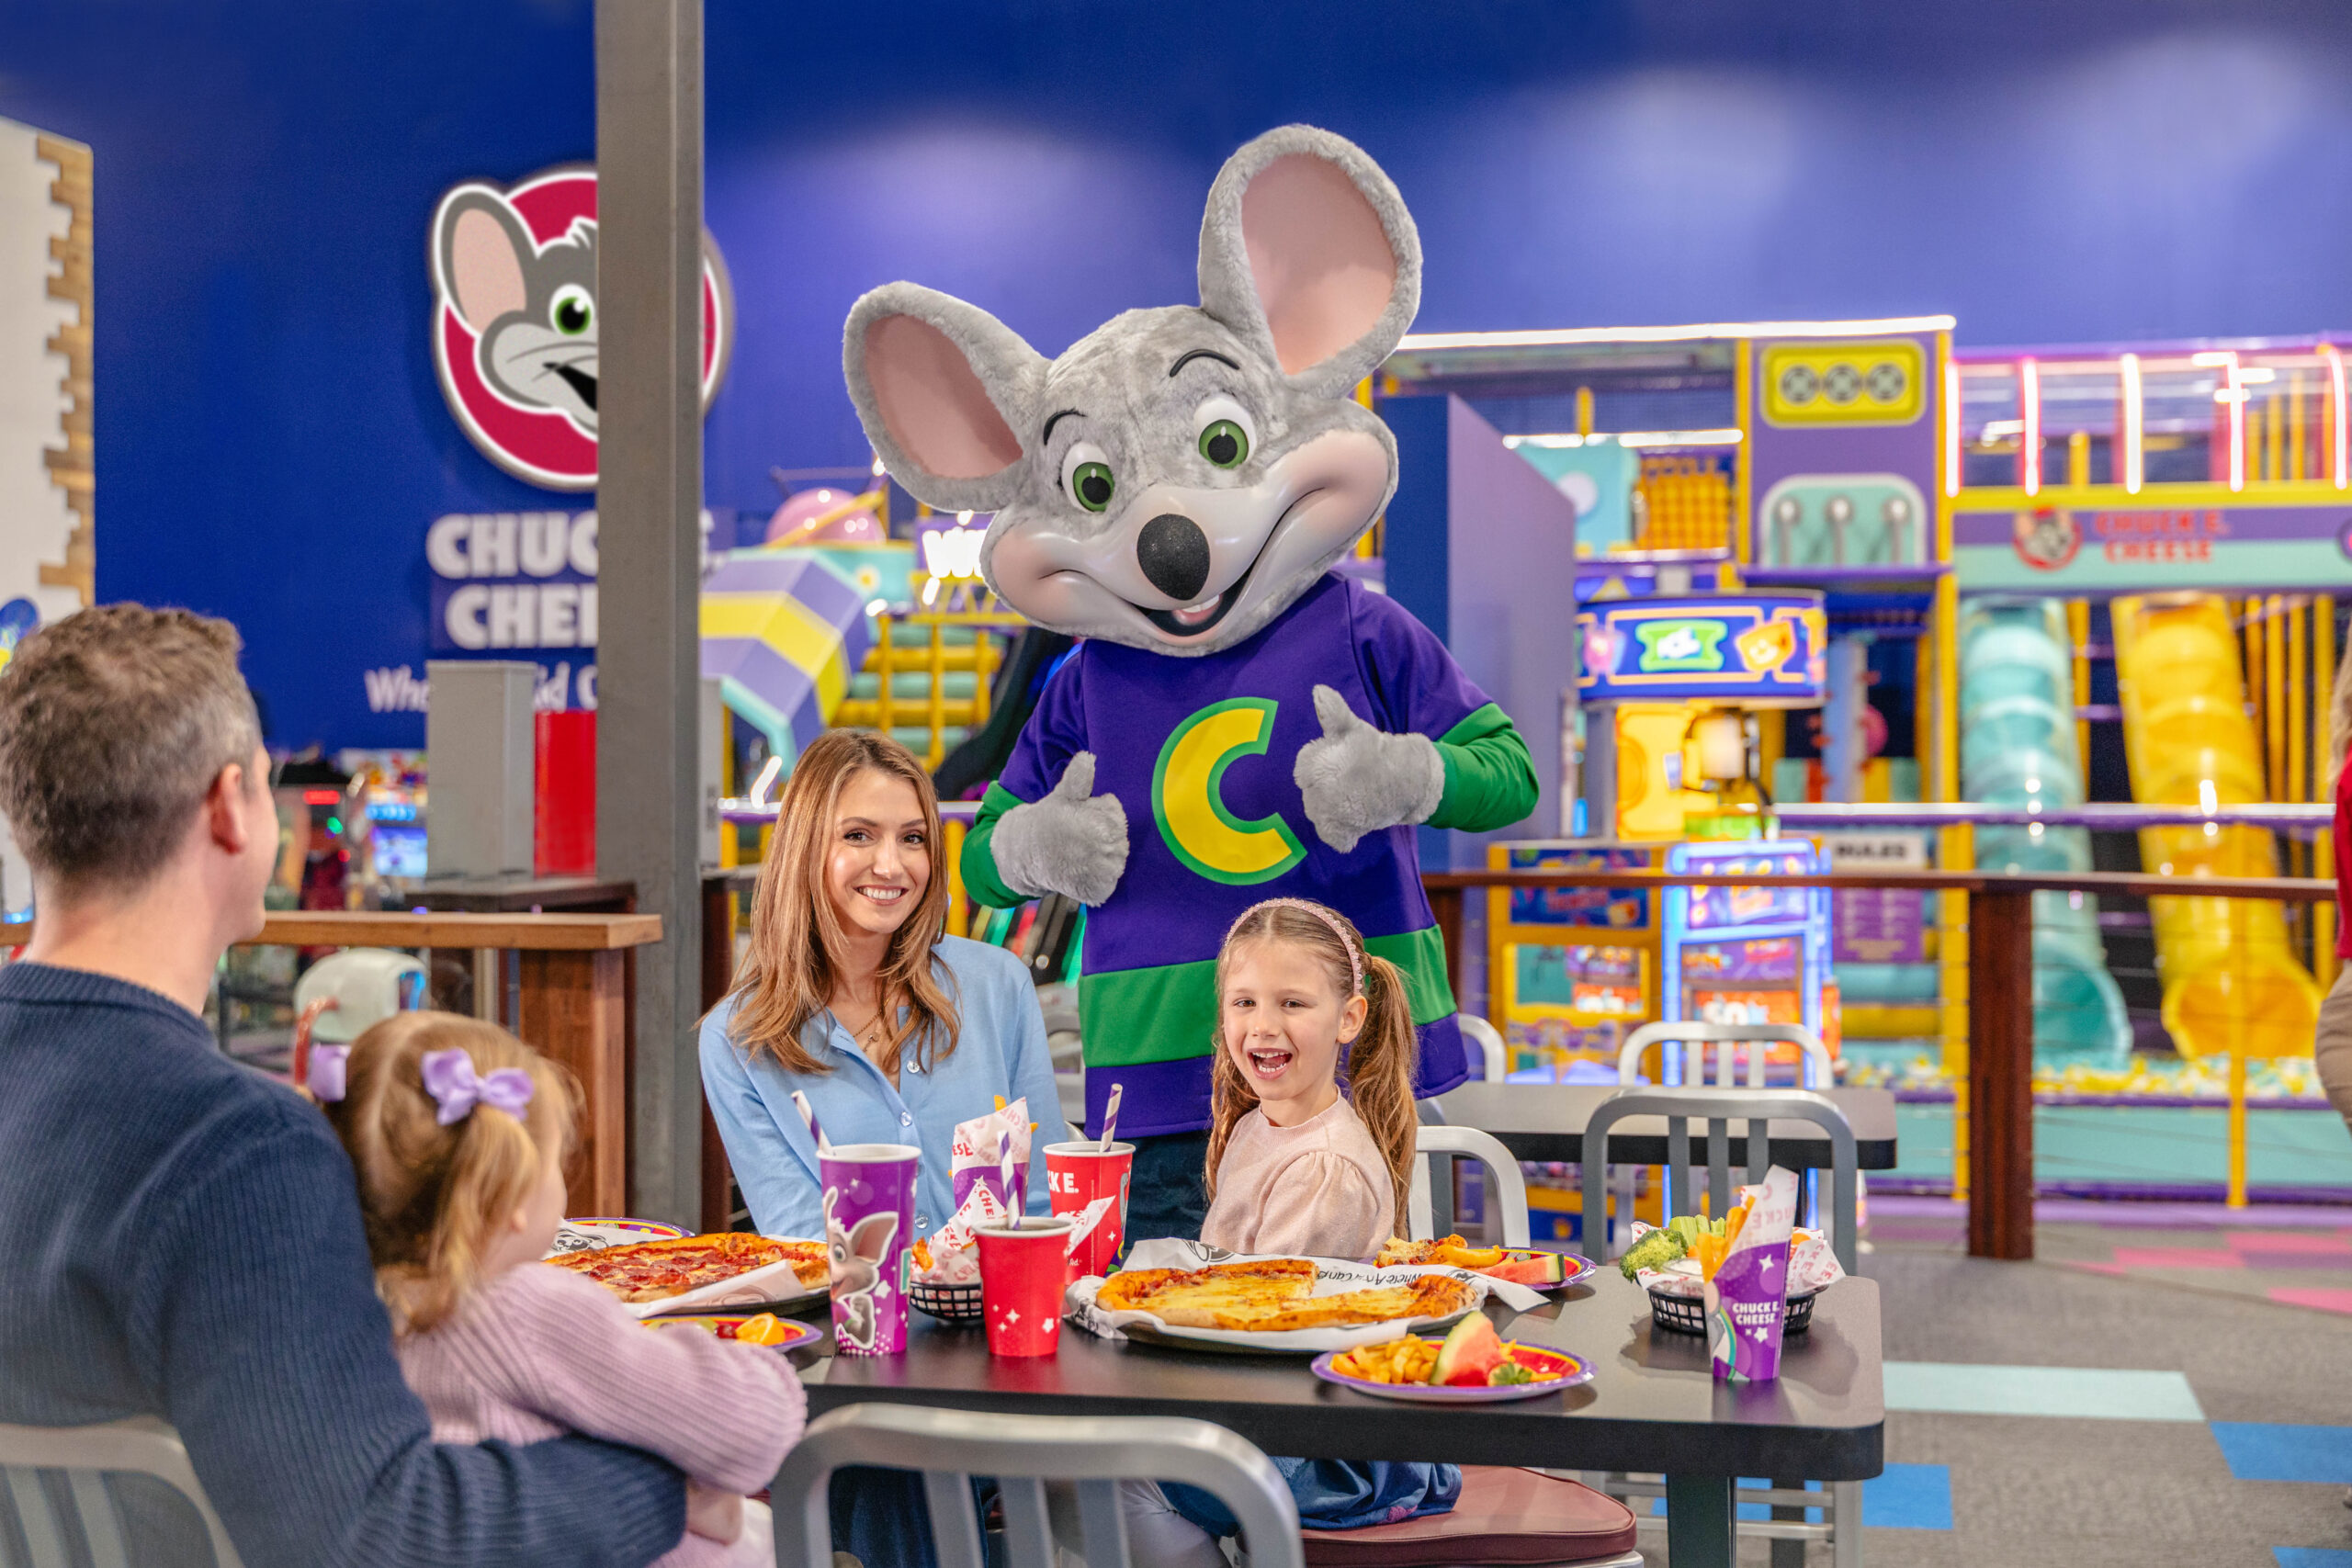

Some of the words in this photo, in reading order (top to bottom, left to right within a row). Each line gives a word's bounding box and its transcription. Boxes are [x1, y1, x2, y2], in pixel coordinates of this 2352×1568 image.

[425, 511, 598, 579] CHUC
[2104, 539, 2213, 563] CHEESE
[445, 583, 598, 649] CHE
[1151, 696, 1308, 886] C
[952, 1142, 974, 1156] ESE
[1063, 1172, 1080, 1194] E.
[978, 1189, 995, 1219] CHE
[1732, 1303, 1771, 1314] CHUCK
[1736, 1313, 1776, 1325] CHEESE
